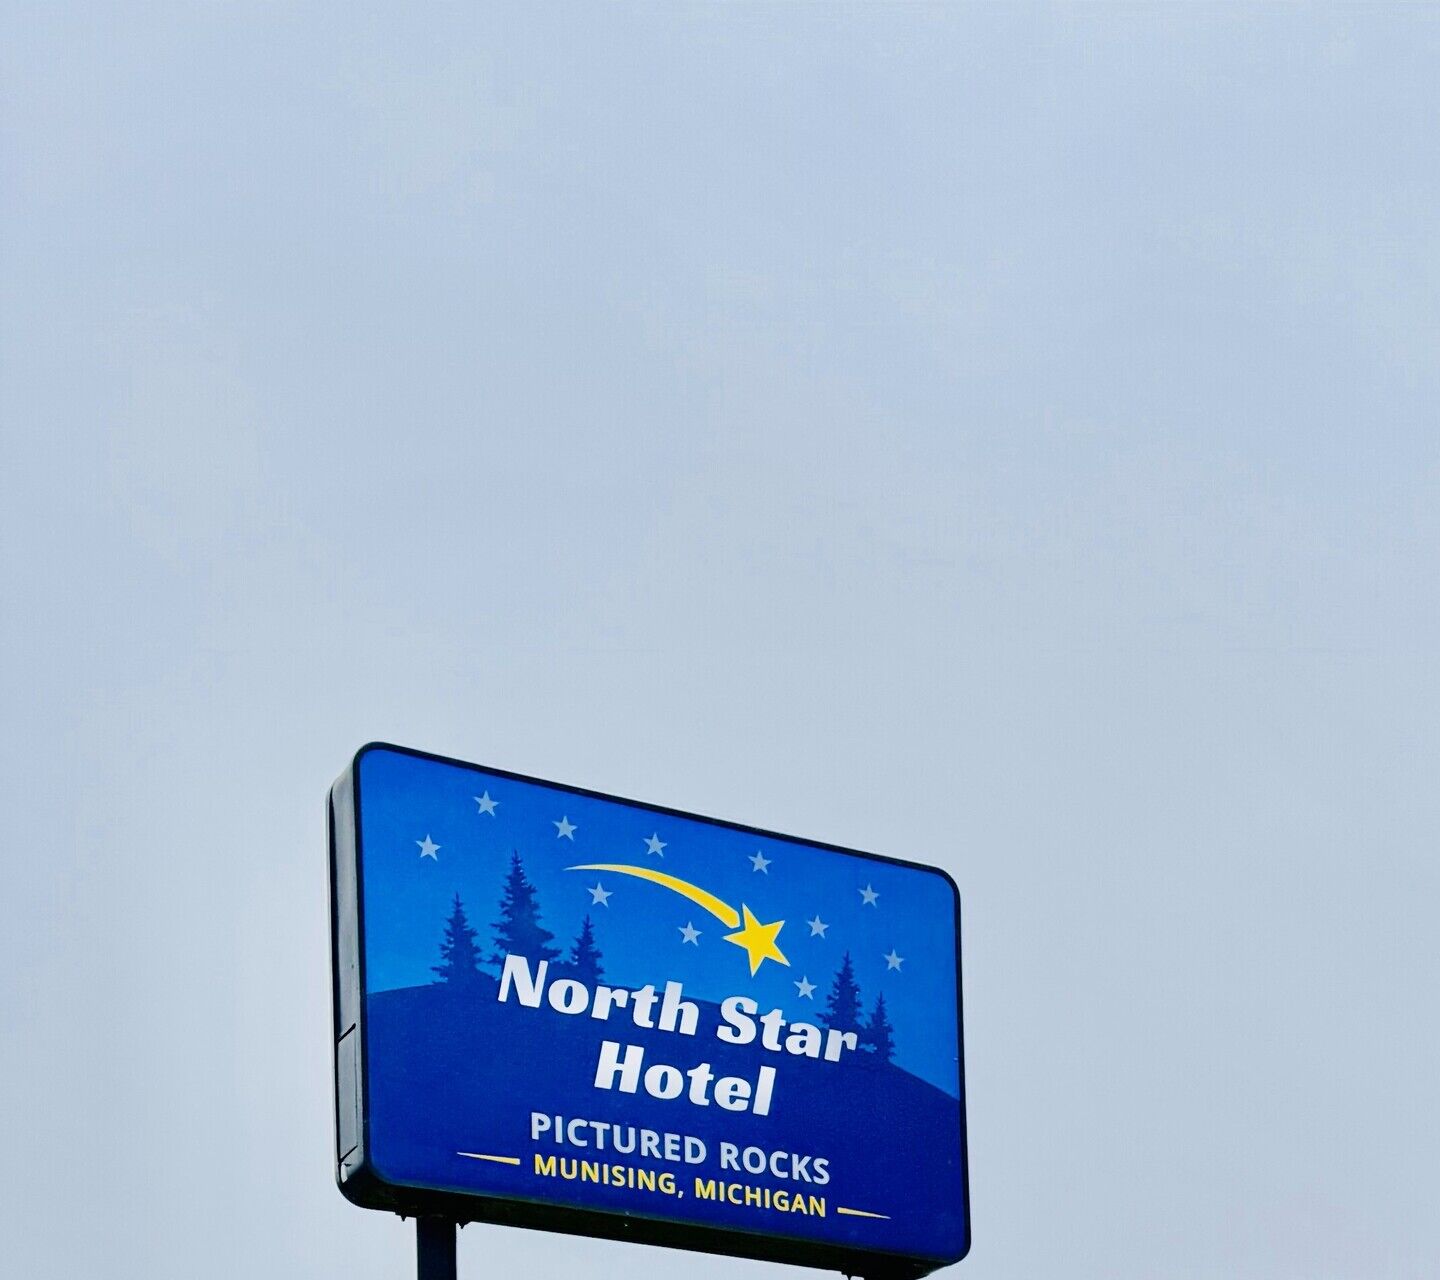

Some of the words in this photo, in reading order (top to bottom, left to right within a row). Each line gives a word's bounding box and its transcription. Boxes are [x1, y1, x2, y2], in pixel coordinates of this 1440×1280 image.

[498, 953, 700, 1036] North
[716, 995, 859, 1063] Star
[593, 1040, 777, 1117] Hotel
[530, 1111, 708, 1165] PICTURED
[719, 1141, 831, 1186] ROCKS
[534, 1153, 685, 1199] MUNISING,
[695, 1177, 827, 1218] MICHIGAN
